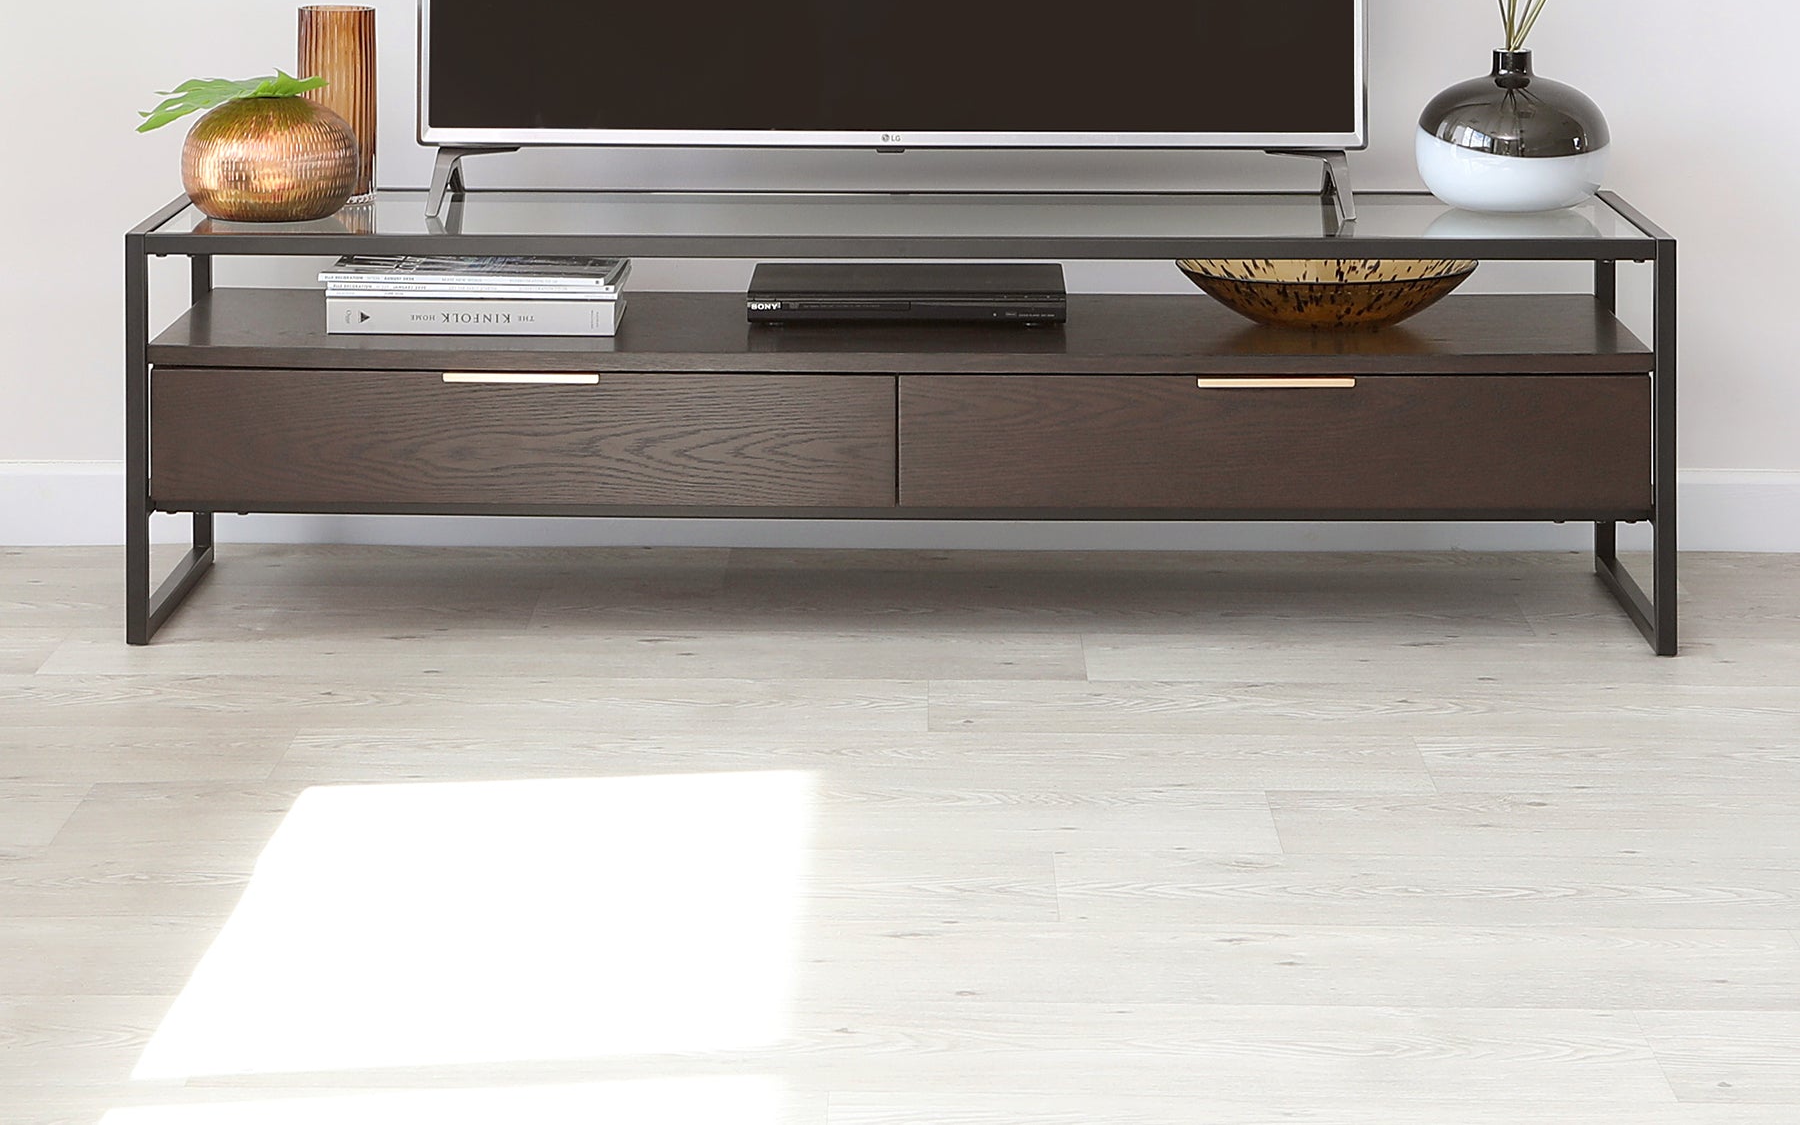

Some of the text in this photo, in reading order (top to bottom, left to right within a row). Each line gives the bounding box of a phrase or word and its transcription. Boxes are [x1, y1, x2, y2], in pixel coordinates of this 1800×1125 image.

[891, 134, 901, 142] LG
[410, 314, 436, 322] HOME
[441, 313, 511, 324] KINFOLK
